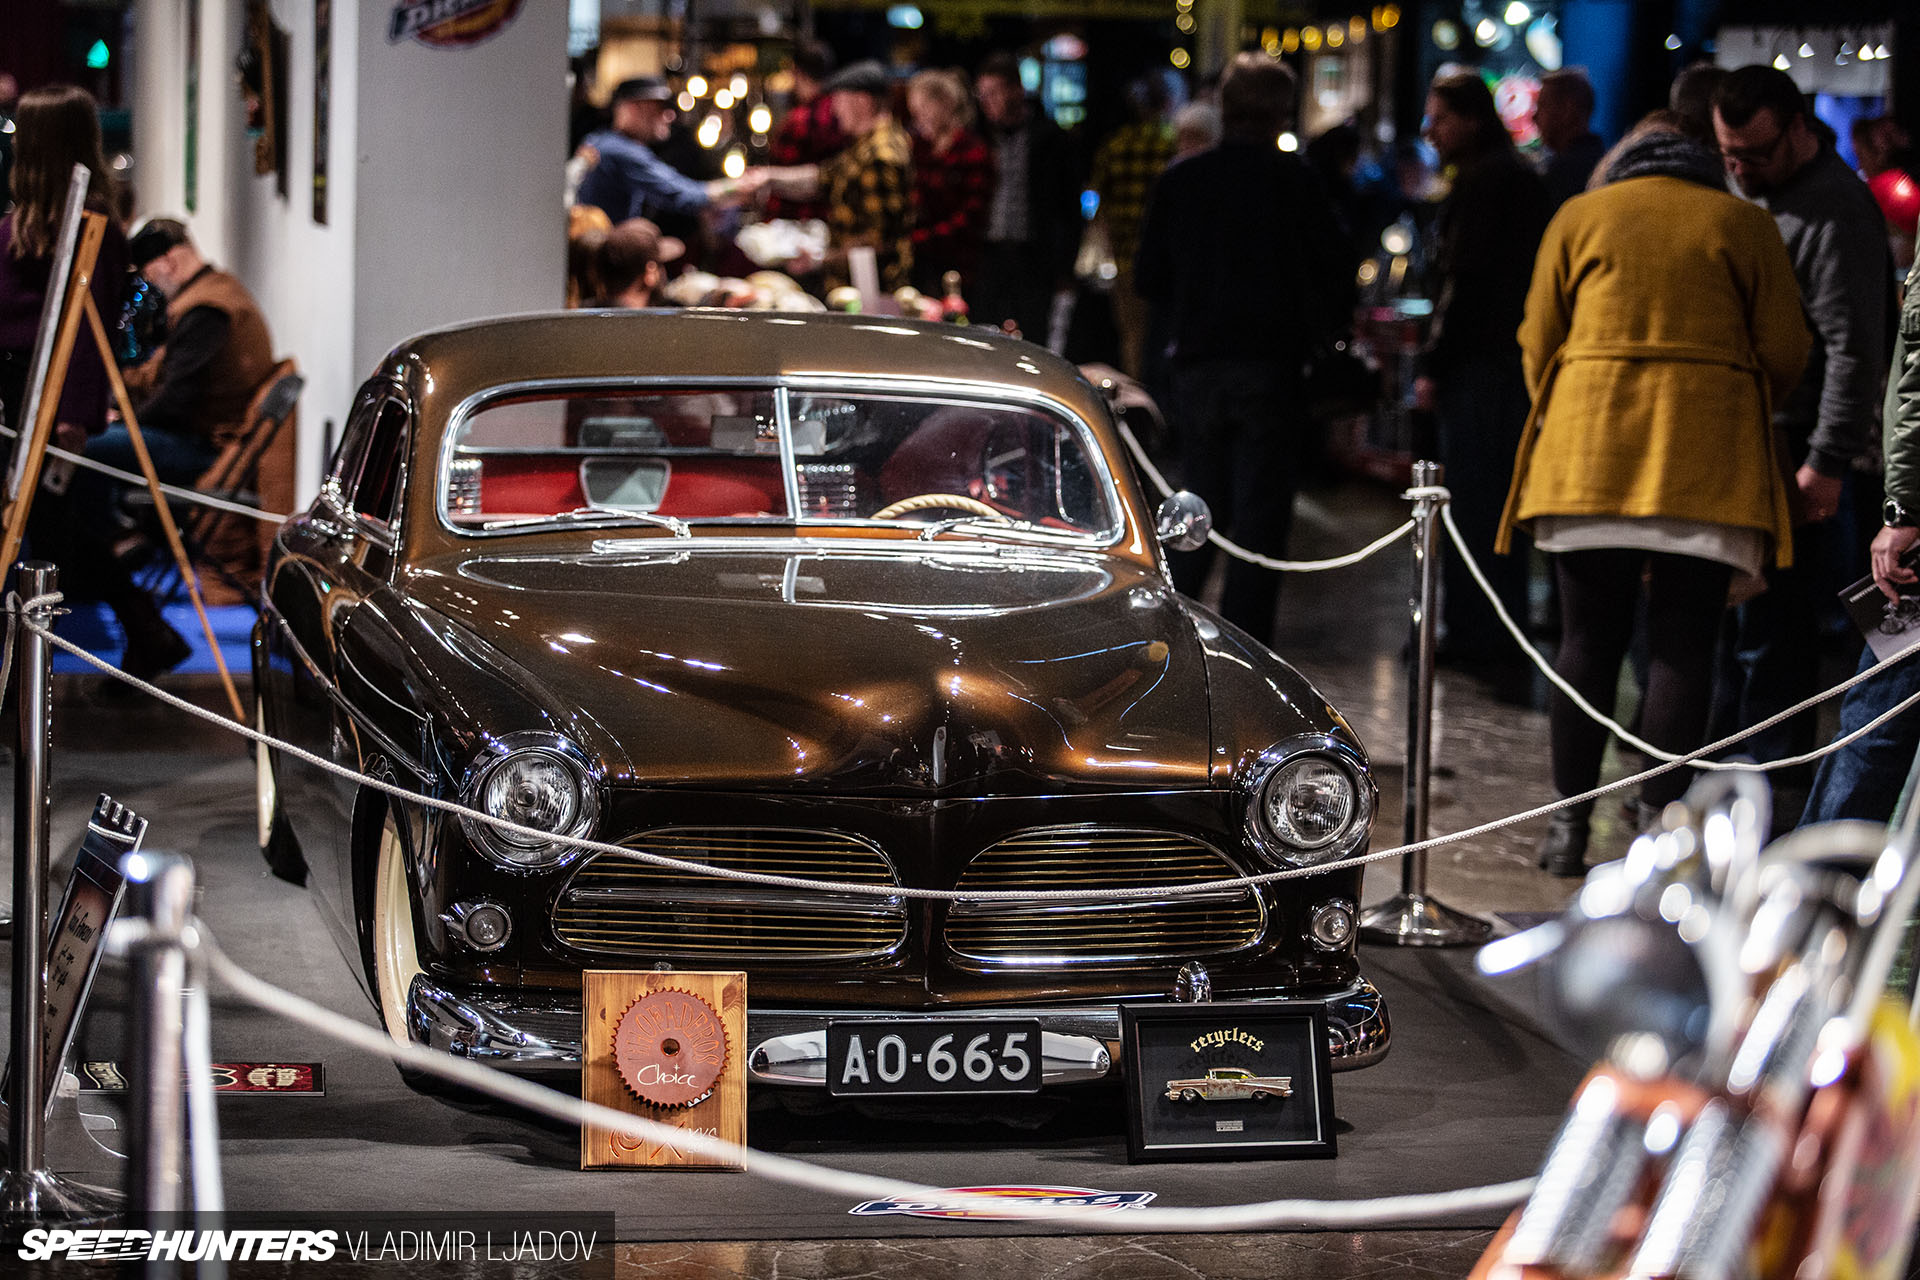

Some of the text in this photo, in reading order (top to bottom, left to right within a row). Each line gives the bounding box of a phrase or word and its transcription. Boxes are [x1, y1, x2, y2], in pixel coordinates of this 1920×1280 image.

[1190, 1027, 1265, 1053] recyclers
[841, 1033, 1031, 1084] AO-665
[637, 1063, 700, 1088] Choice
[887, 1195, 1122, 1210] Dikies
